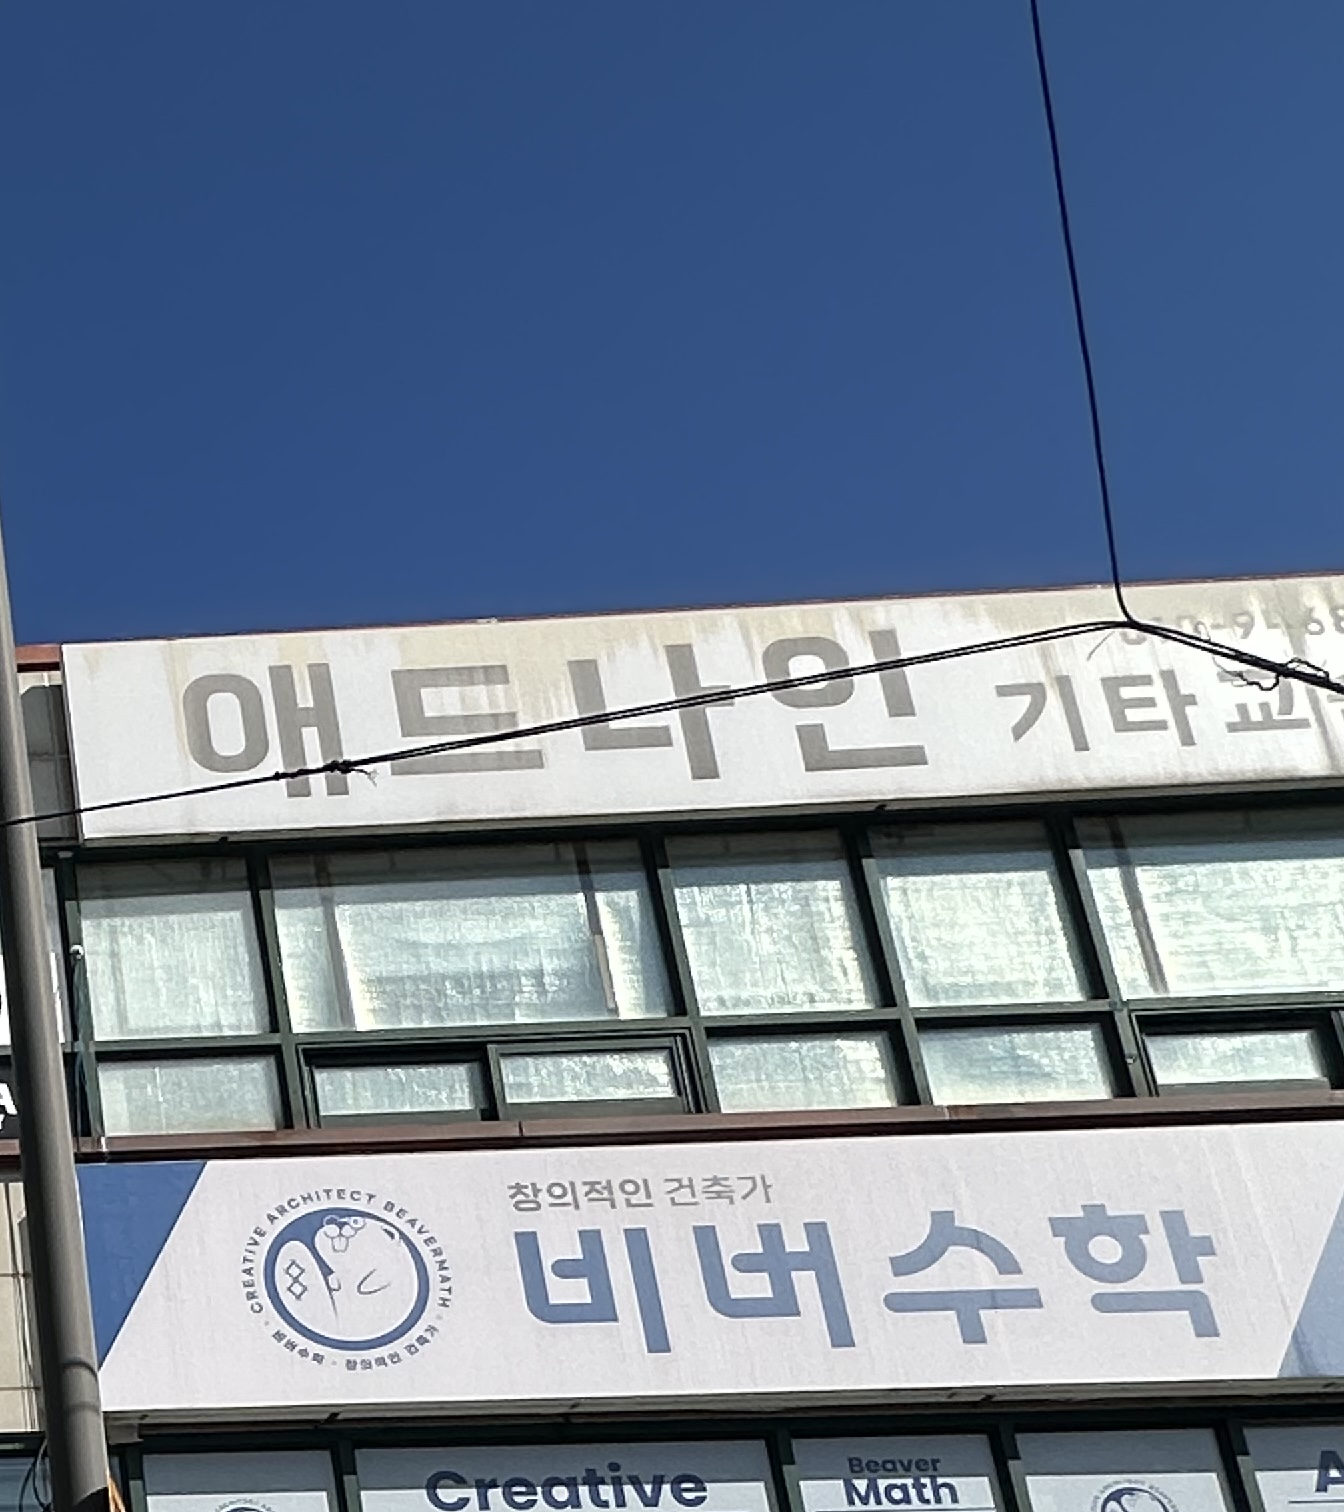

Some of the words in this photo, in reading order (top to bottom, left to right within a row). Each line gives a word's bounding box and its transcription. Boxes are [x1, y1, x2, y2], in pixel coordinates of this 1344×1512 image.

[182, 628, 929, 798] 애드나인
[995, 664, 1344, 752] 기타교
[507, 1179, 652, 1212] 창의적인
[664, 1173, 773, 1207] 건축가
[242, 1225, 268, 1316] CREATIVE
[265, 1188, 378, 1227] ARCHITECT
[382, 1200, 453, 1309] BEAVERMATH
[514, 1203, 1219, 1354] 비버수학
[425, 1462, 708, 1512] Creative
[847, 1456, 941, 1476] Beaver
[843, 1475, 959, 1509] Math
